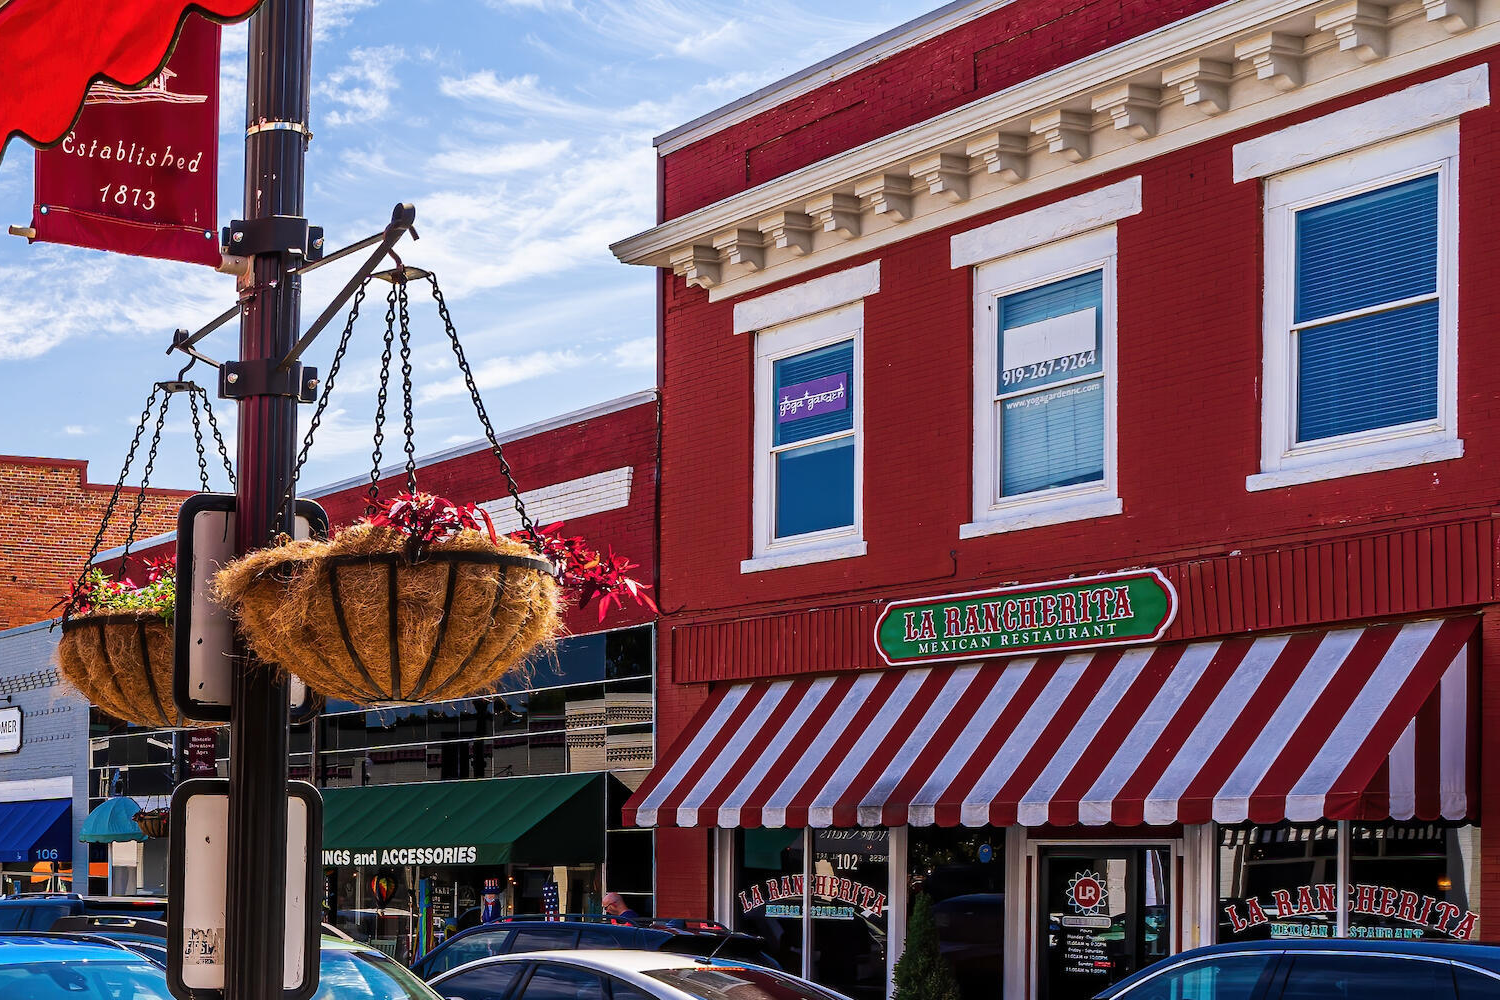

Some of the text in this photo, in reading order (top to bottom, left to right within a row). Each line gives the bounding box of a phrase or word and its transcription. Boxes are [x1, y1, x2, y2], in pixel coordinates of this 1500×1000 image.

[62, 131, 202, 173] Established
[99, 183, 156, 211] 1873
[1002, 352, 1096, 386] 919-267-9264
[779, 396, 803, 416] yoga
[1006, 382, 1100, 410] www.yogagardennc.com
[903, 585, 1134, 642] LA RANCHERITA
[918, 623, 1118, 654] MEXICAN RESTAURANT
[35, 849, 58, 859] 106
[354, 850, 377, 865] and
[381, 847, 477, 865] ACCESSORIES
[837, 854, 858, 870] 102
[739, 884, 764, 913] LA
[1078, 886, 1095, 900] LR
[1225, 896, 1268, 933] LA
[1272, 924, 1328, 938] MEXICAN
